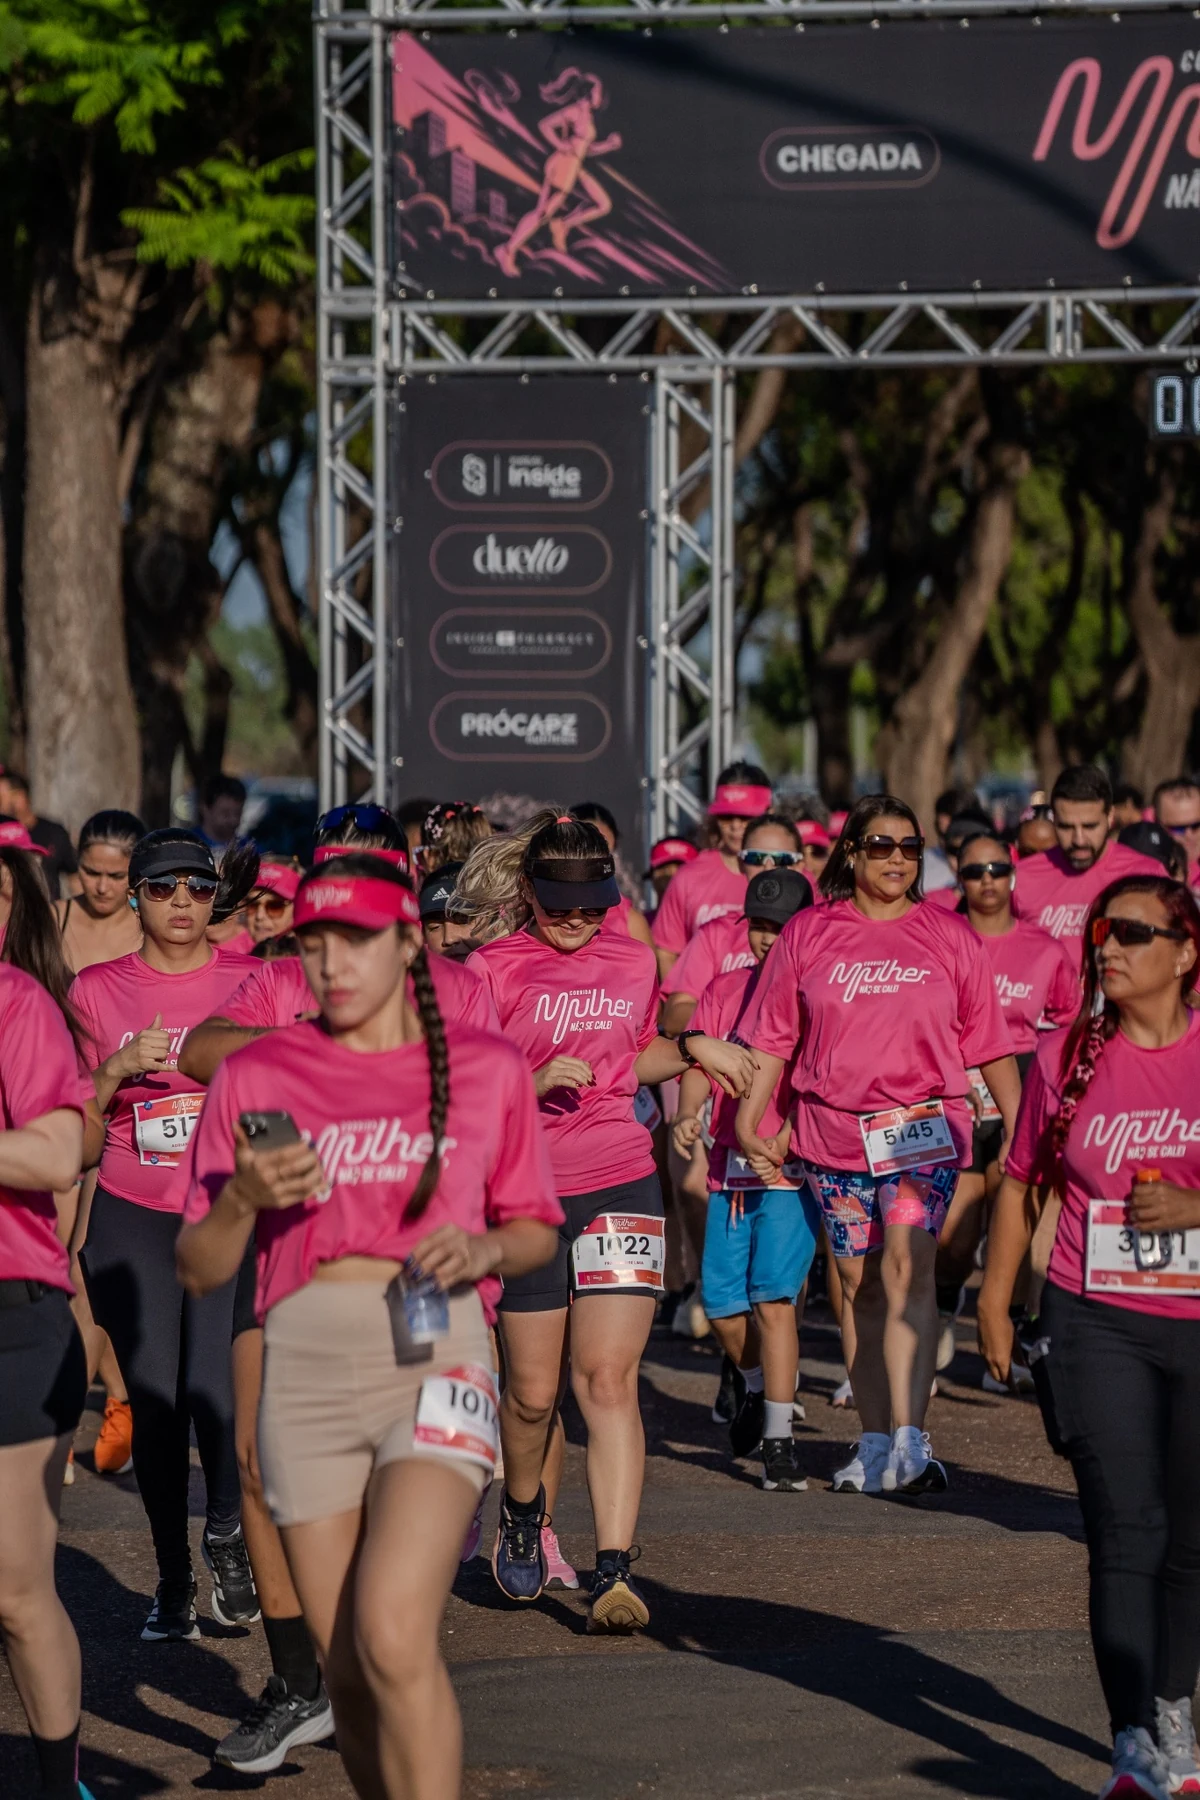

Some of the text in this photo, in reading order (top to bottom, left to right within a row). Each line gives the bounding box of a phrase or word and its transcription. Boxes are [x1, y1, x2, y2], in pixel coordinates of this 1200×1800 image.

[776, 142, 923, 173] CHEGADA
[1154, 375, 1200, 434] 0
[472, 533, 569, 574] duello
[585, 1021, 594, 1030] SE
[883, 1121, 934, 1146] 5145
[596, 1235, 651, 1256] 1022
